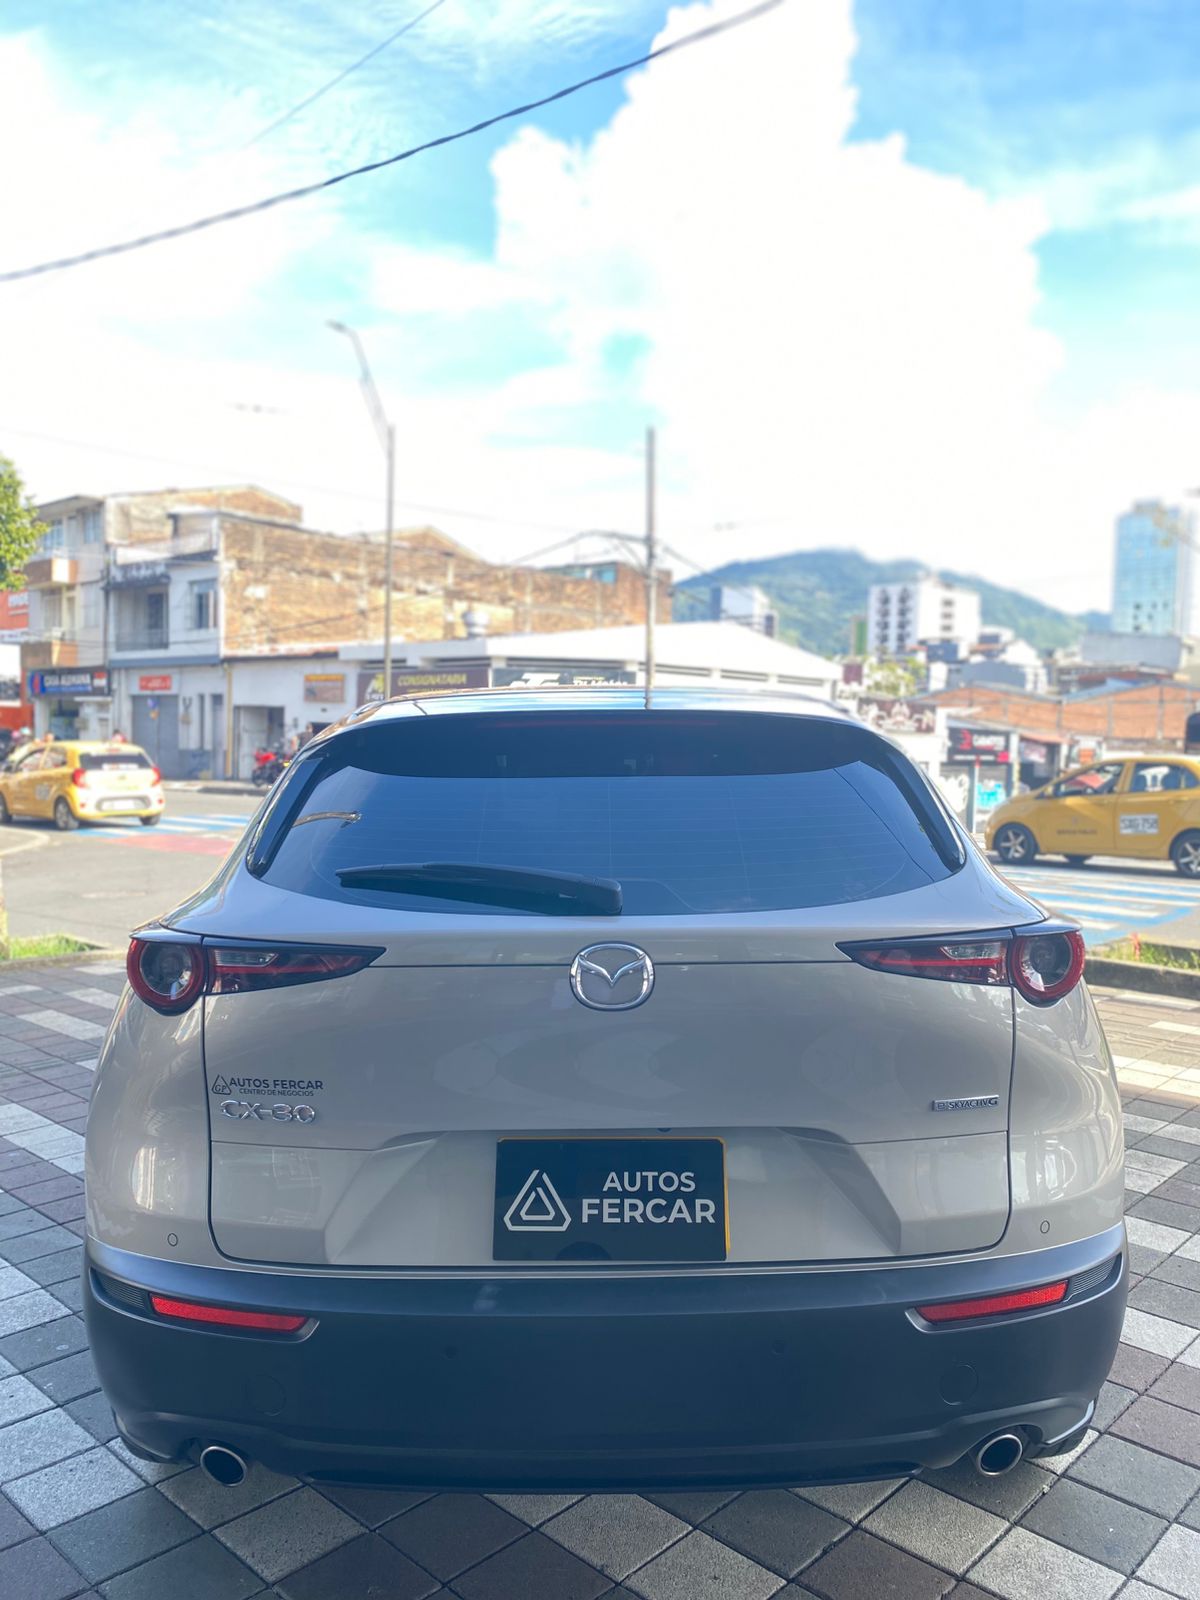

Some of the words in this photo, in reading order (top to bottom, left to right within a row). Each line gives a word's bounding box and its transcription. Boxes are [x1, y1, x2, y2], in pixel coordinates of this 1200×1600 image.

[229, 1077, 270, 1089] AUTOS
[273, 1079, 324, 1090] FERCAR
[239, 1088, 267, 1096] CENTRO
[277, 1089, 314, 1097] NEGOCIOS
[220, 1099, 315, 1124] CX-30
[602, 1171, 696, 1192] AUTOS
[581, 1198, 716, 1224] FERCAR
